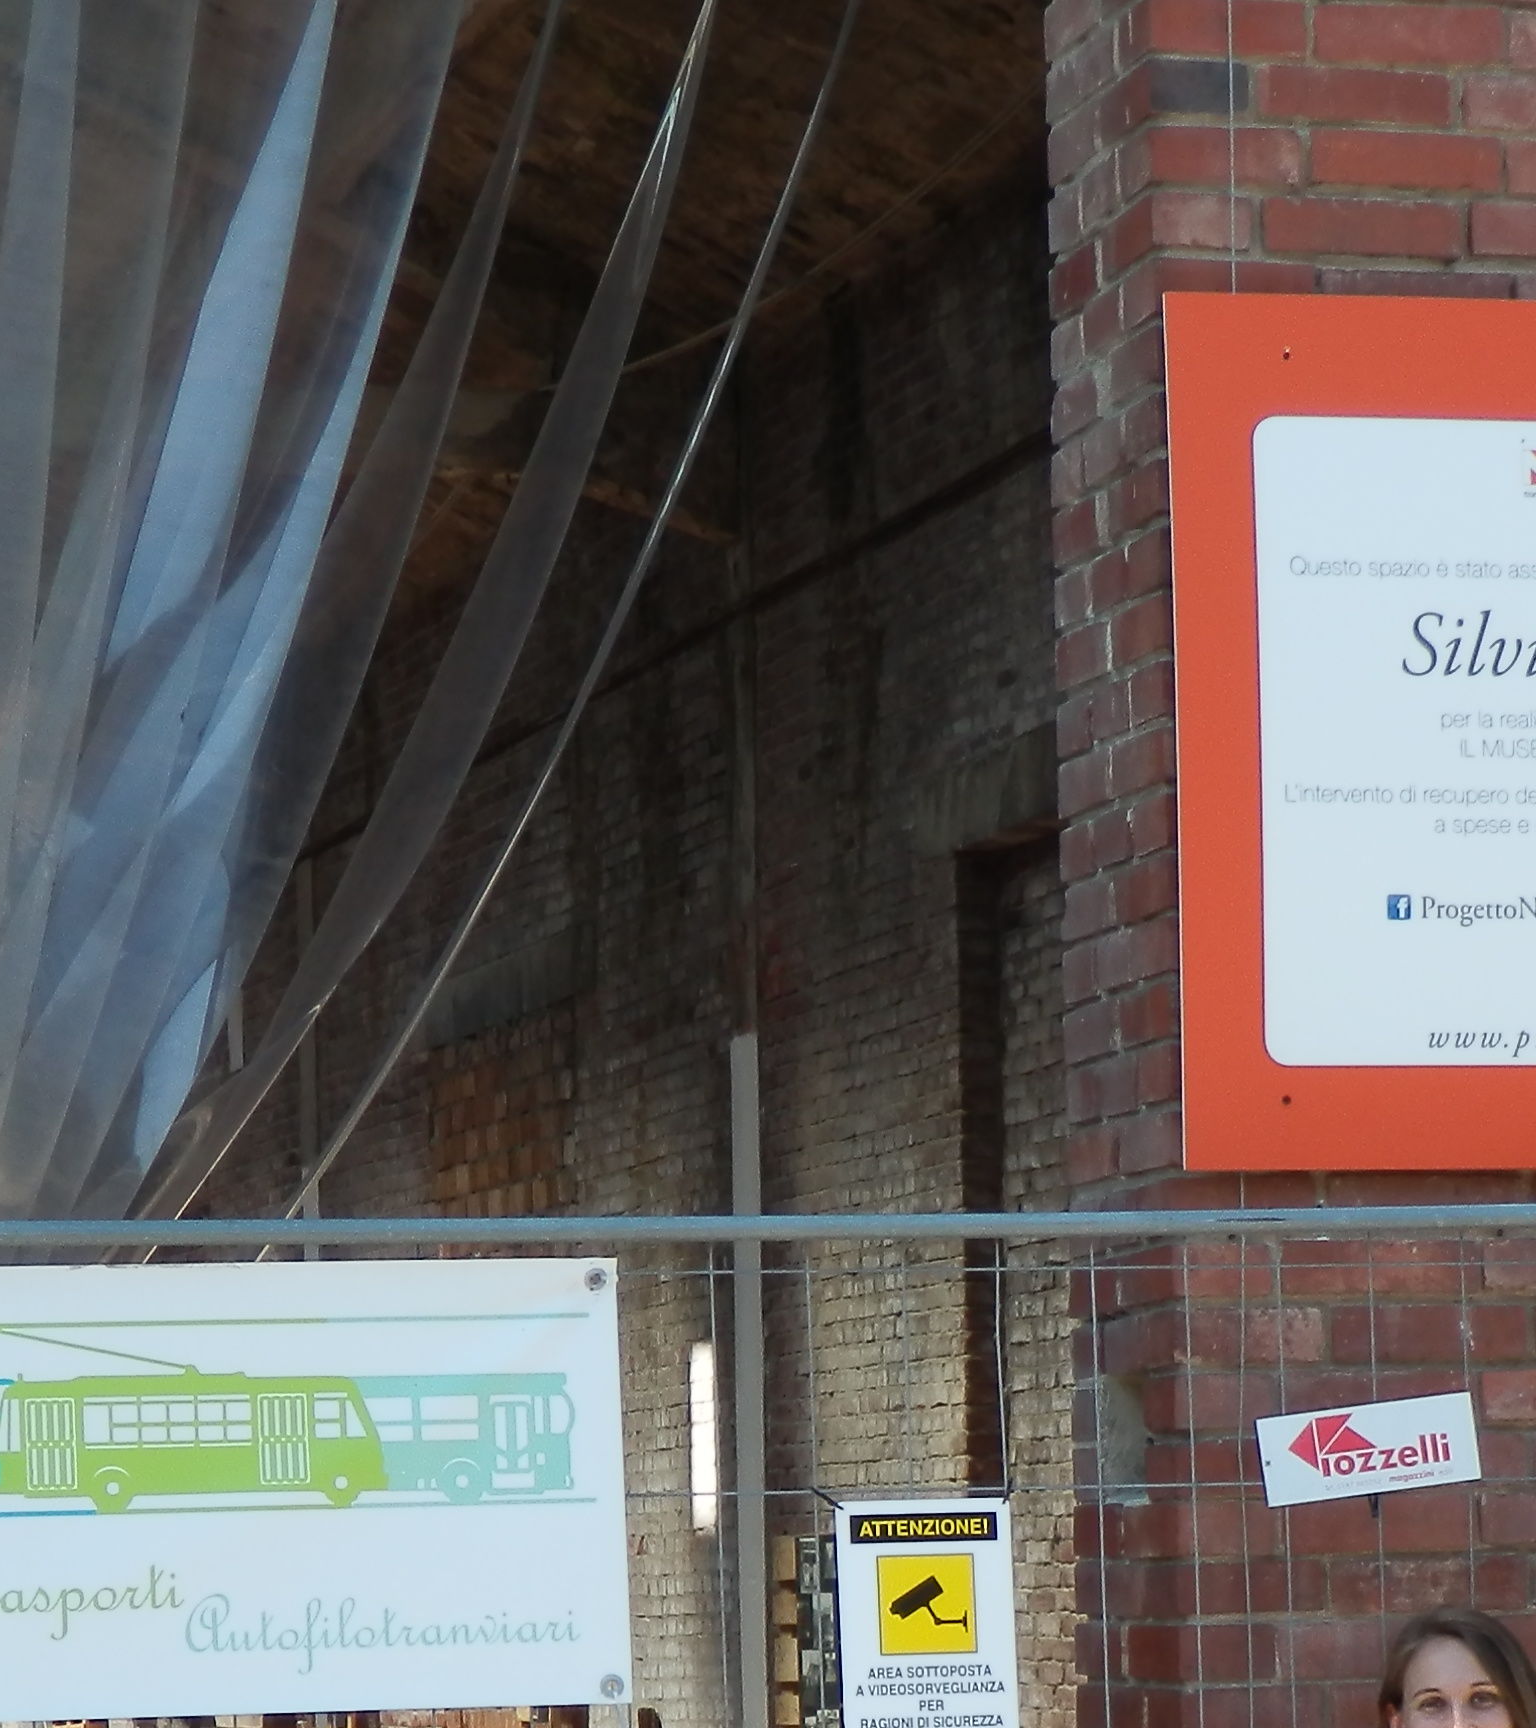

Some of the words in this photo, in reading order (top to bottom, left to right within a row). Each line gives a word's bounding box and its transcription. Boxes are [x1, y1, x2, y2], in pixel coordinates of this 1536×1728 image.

[1288, 555, 1362, 577] Questo
[1367, 558, 1431, 580] spazio
[1435, 558, 1449, 579] è
[1454, 560, 1503, 580] stato
[1439, 712, 1472, 732] per
[1477, 709, 1494, 729] la
[1459, 738, 1476, 759] IL
[1283, 784, 1394, 804] L'intervento
[1399, 784, 1417, 804] di
[1422, 787, 1510, 808] recupero
[1433, 817, 1446, 834] a
[1452, 817, 1511, 837] spese
[1517, 818, 1529, 834] e
[859, 1517, 989, 1538] ATTENZIONE!
[185, 1592, 583, 1676] Autofilotranviari
[867, 1667, 903, 1679] AREA
[907, 1664, 993, 1679] SOTTOPOSTA
[855, 1685, 865, 1697] A
[868, 1681, 1006, 1697] VIDEOSORVEGLIANZA
[919, 1700, 945, 1712] PER
[917, 1716, 930, 1728] DI
[933, 1715, 1004, 1728] SICUREZZA
